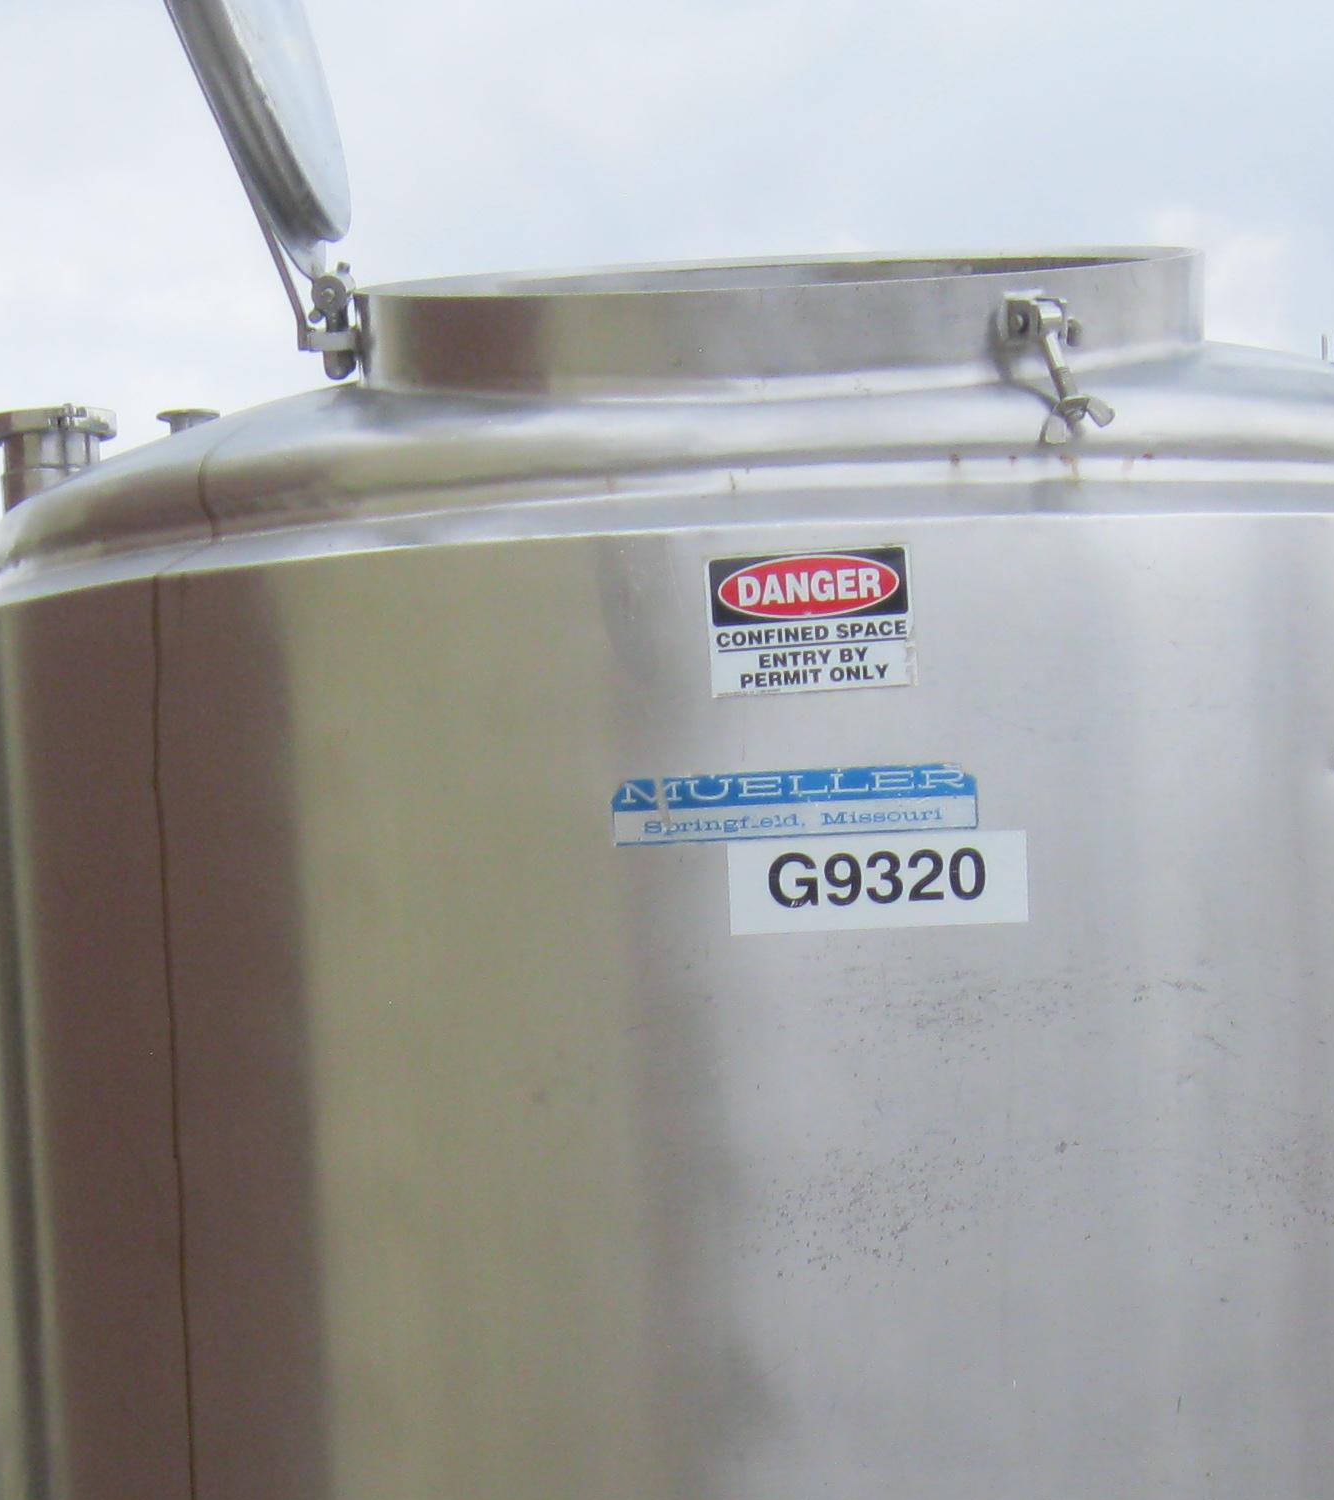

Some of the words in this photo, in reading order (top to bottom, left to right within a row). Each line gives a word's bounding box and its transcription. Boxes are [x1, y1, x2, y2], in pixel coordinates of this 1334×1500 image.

[737, 568, 882, 607] DANGER
[717, 625, 829, 648] CONFINED
[836, 620, 907, 639] SPACE
[759, 650, 832, 669] ENTRY
[839, 647, 869, 663] BY
[740, 668, 822, 688] PERMIT
[829, 664, 889, 682] ONLY
[820, 807, 944, 826] Missouri
[768, 847, 986, 908] G9320
